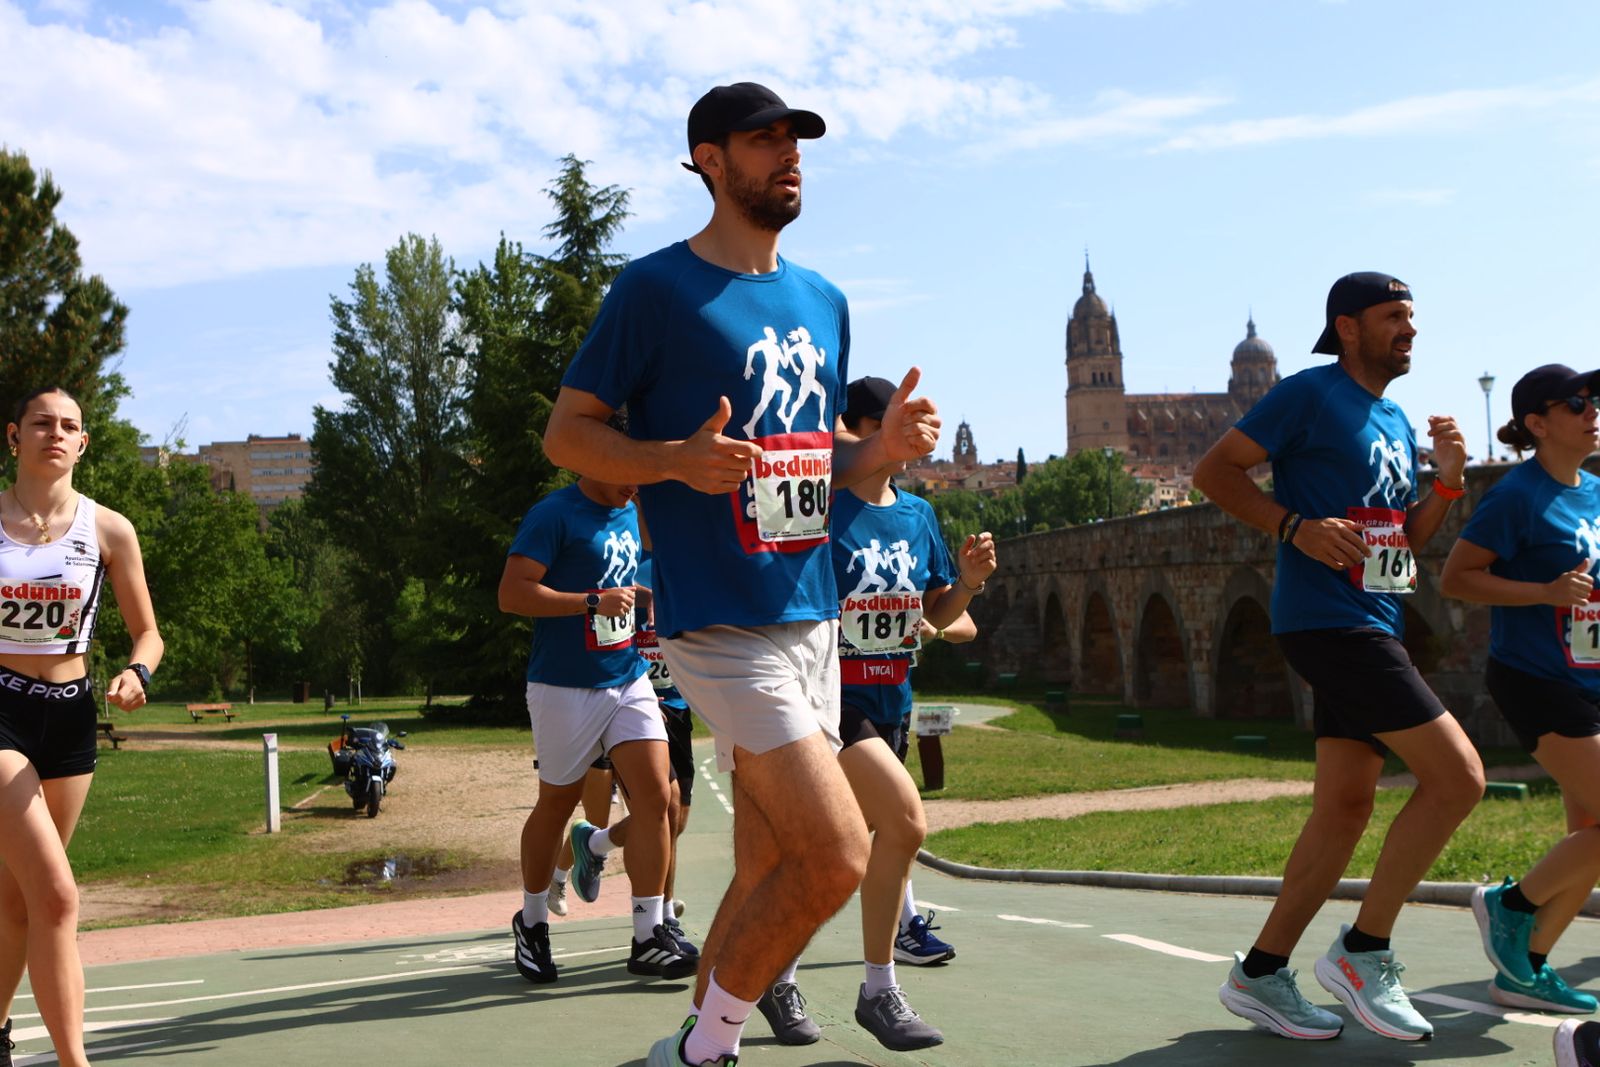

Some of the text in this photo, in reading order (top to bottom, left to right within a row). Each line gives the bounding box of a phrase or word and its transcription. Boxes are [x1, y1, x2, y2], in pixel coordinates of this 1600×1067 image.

[776, 479, 826, 519] 180
[1378, 549, 1410, 577] 161
[1, 600, 65, 630] 220
[844, 594, 921, 612] bedunia
[1574, 606, 1600, 622] be
[856, 612, 907, 640] 181
[28, 683, 79, 699] PRO
[1336, 956, 1365, 991] HOKA
